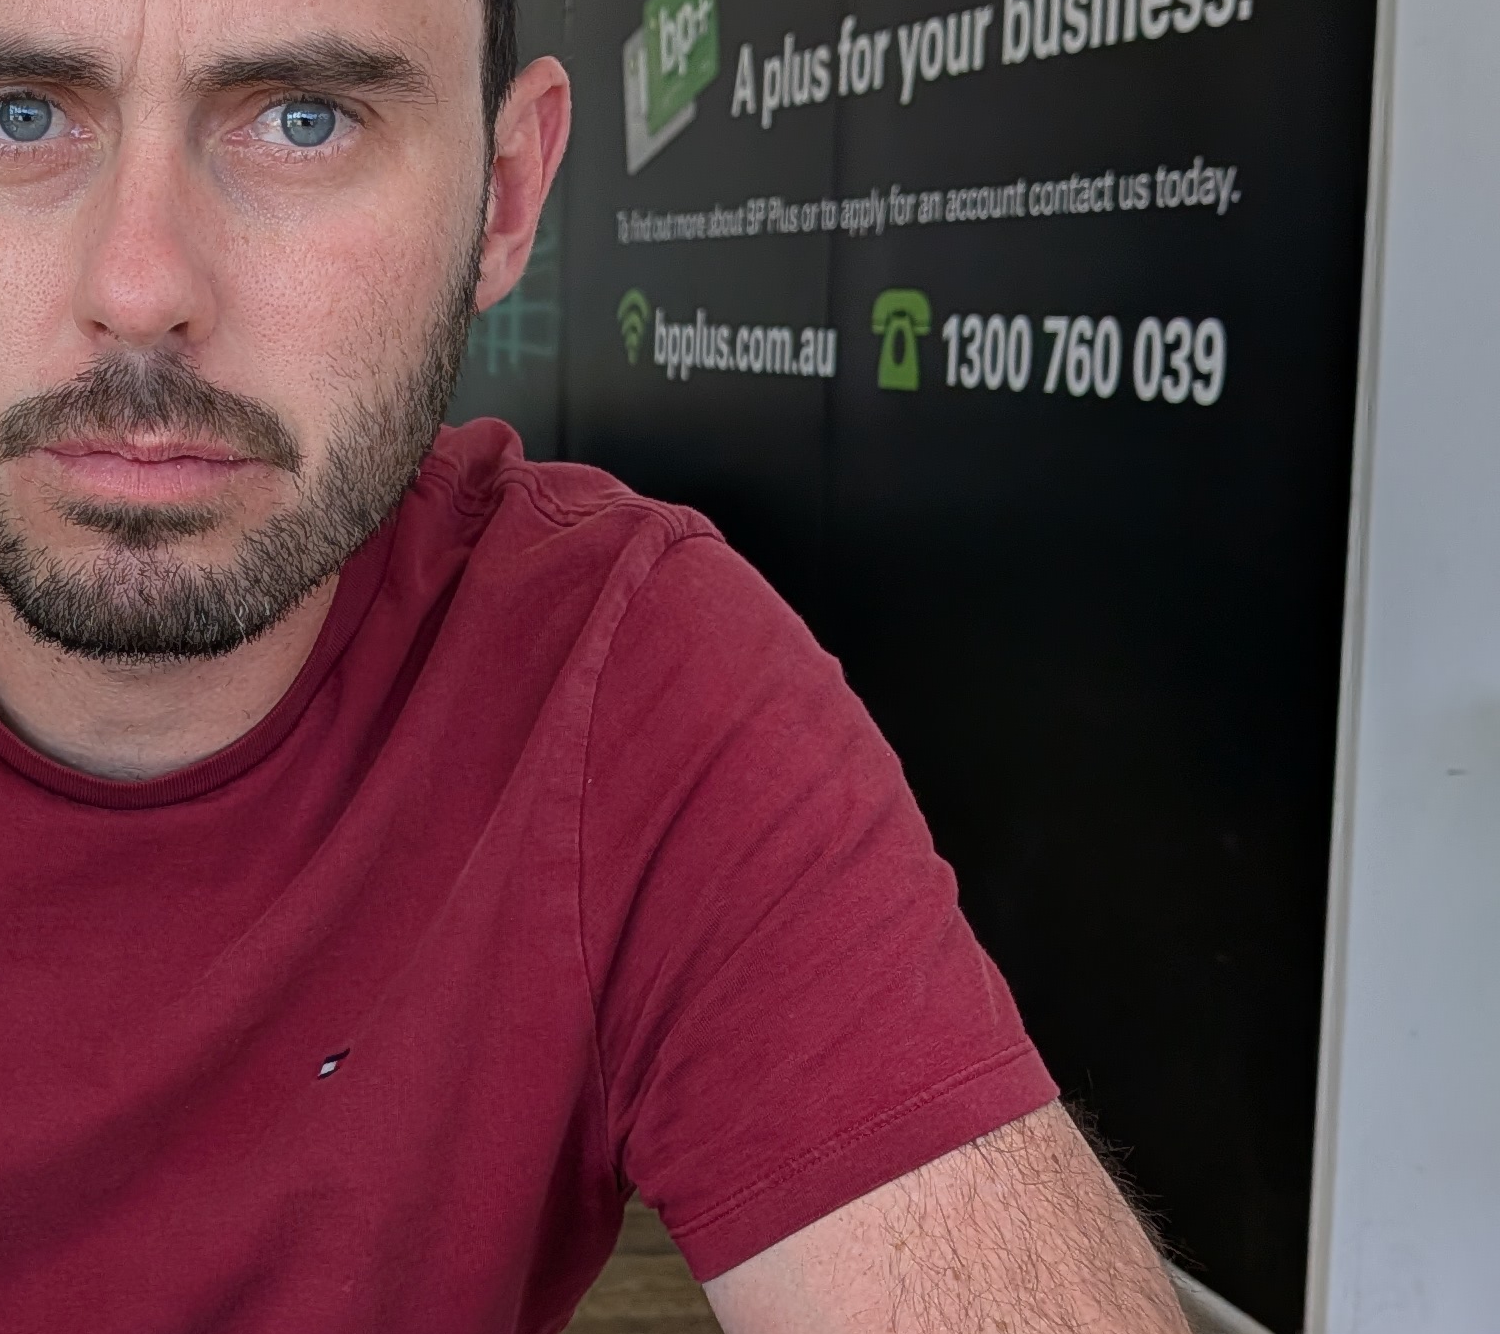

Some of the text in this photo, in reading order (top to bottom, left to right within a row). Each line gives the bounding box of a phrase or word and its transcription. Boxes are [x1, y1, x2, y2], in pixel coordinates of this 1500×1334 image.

[731, 43, 757, 118] A
[761, 33, 831, 129] plus
[838, 15, 891, 96] for
[898, 4, 994, 105] your
[707, 203, 744, 238] about
[746, 197, 767, 235] BP
[767, 196, 800, 233] Plus
[801, 203, 820, 232] or
[821, 198, 839, 230] to
[840, 187, 886, 237] apply
[889, 184, 917, 225] for
[918, 190, 944, 223] an
[945, 177, 1026, 222] account
[1028, 169, 1114, 216] contact
[1118, 173, 1150, 210] us
[1155, 155, 1242, 216] today.
[654, 308, 838, 381] bpplus.com.au
[942, 313, 1227, 406] 1300 760 039
